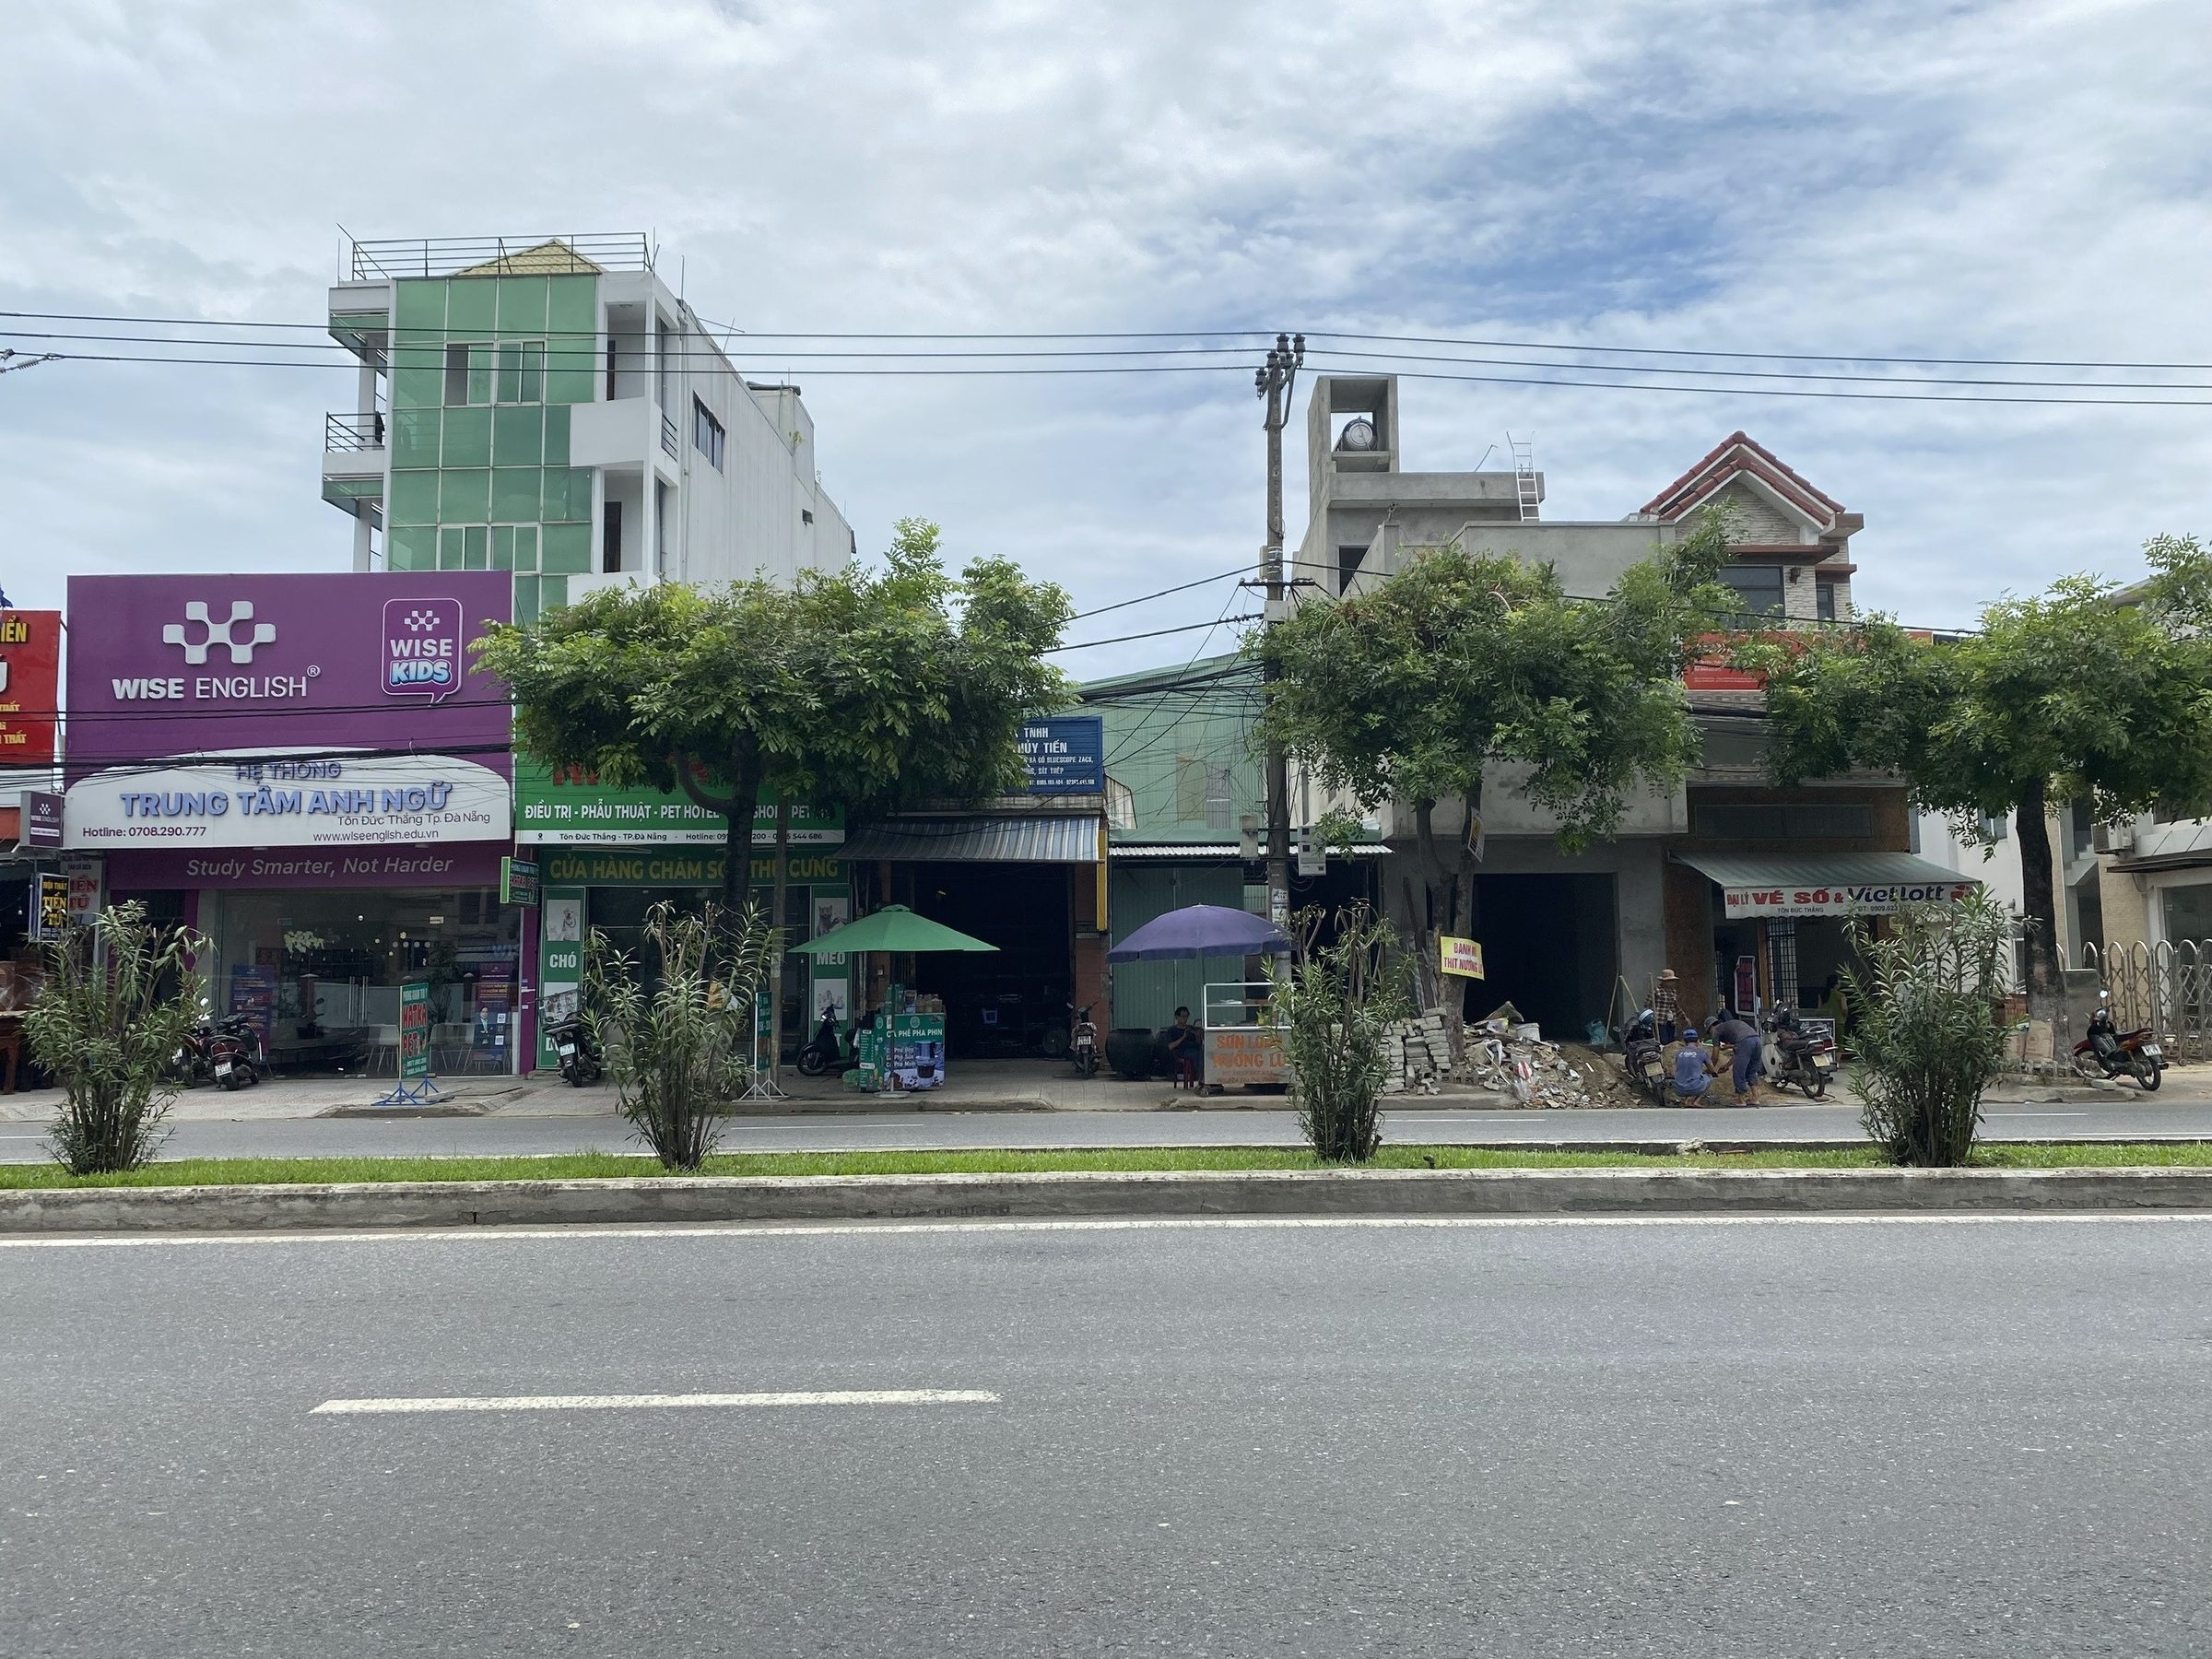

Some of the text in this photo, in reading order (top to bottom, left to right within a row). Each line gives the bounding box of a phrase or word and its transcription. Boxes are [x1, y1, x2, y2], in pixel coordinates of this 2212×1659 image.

[390, 638, 453, 657] WISE
[390, 659, 452, 686] KIDS
[112, 676, 307, 700] WISE ENGLISH
[1024, 727, 1049, 738] TNHH
[1043, 739, 1067, 754] TIẾN
[120, 781, 453, 817] TRUNG TÂM ANH NGỮ
[338, 809, 490, 827] Tôn Đức Thắng Tp. Đà Nẵng
[524, 799, 551, 819] ĐIỀU
[554, 805, 572, 822] TRỊ
[581, 797, 612, 819] PHẪU
[615, 802, 652, 822] THUẬT
[660, 805, 680, 819] PET
[83, 826, 206, 837] Hotline: 0708.290.777
[313, 829, 439, 842] www.wiseenglish.edu.vn
[559, 832, 573, 841] Tôn
[575, 831, 591, 841] Đức
[593, 831, 616, 842] Thắng
[623, 831, 644, 841] TP.Đà
[646, 831, 667, 842] Nẵng
[686, 832, 715, 841] Hotline:
[793, 832, 807, 841] 544
[187, 856, 453, 879] Study Smarter, Not Harder
[549, 853, 587, 878] CỬA
[593, 855, 644, 879] HÀNG
[649, 857, 703, 879] CHĂM
[1740, 892, 1749, 905] LÝ
[1752, 889, 1784, 905] VÉ
[1794, 888, 1830, 904] SỐ
[1834, 892, 1843, 904] &
[1847, 885, 1945, 903] Vietlott
[549, 951, 577, 969] CHÓ
[1444, 957, 1458, 971] THỊT
[898, 1028, 911, 1038] PHÊ
[912, 1028, 926, 1037] PHA
[927, 1028, 943, 1037] PHIN
